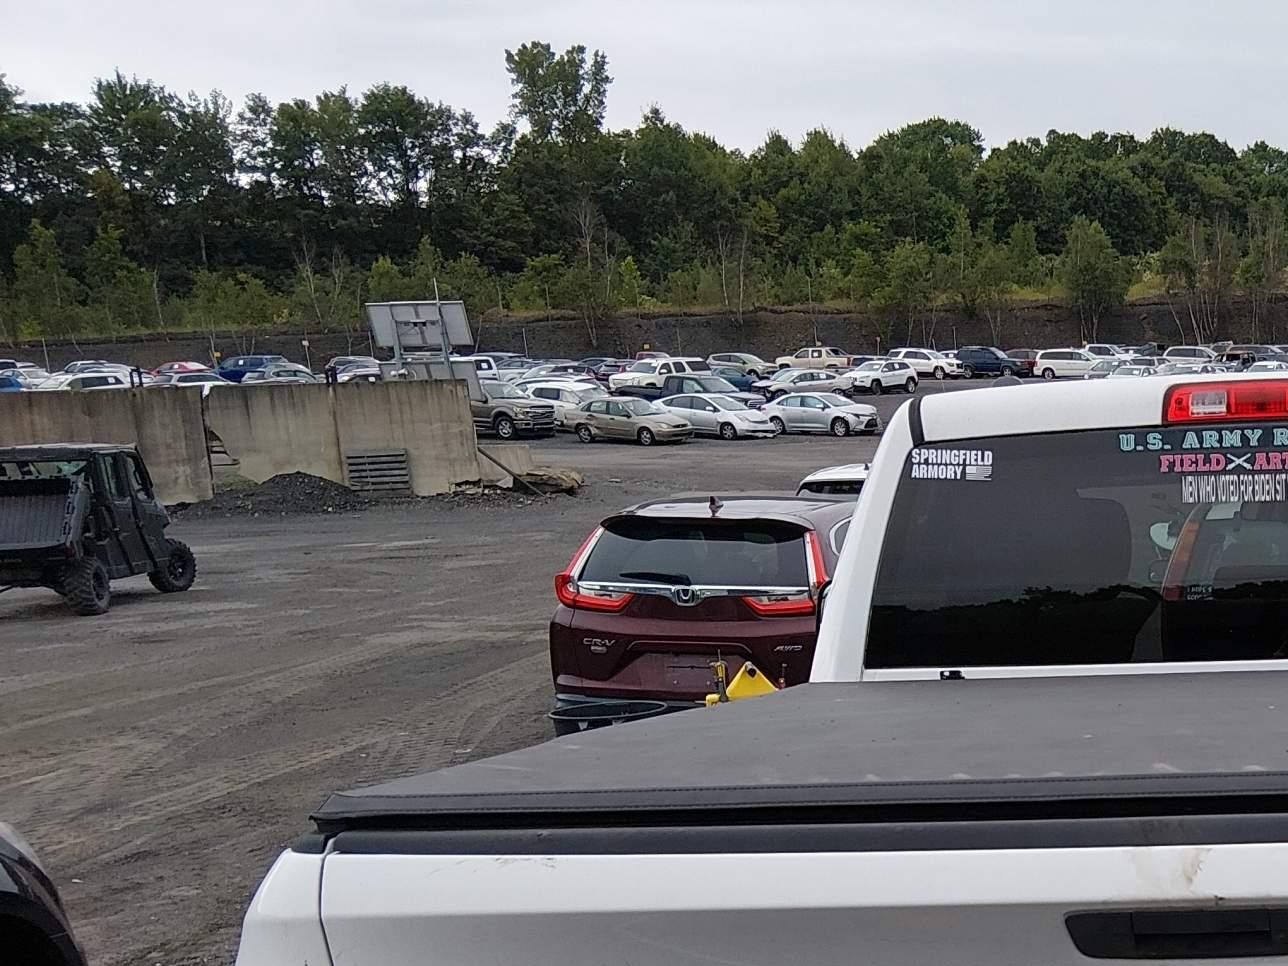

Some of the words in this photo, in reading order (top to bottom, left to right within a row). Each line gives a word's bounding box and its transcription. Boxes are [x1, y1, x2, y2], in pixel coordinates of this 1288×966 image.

[1119, 433, 1171, 450] U.S.
[1182, 429, 1263, 448] ARMY
[911, 448, 993, 465] SPRINGFIELD
[1160, 453, 1226, 472] FIELD
[911, 464, 963, 479] ARMORY
[1182, 475, 1198, 503] MEN
[1199, 475, 1216, 502] WHO
[1217, 474, 1239, 502] VOTED
[1240, 474, 1253, 501] FOR
[1254, 473, 1274, 501] BIDEN
[1276, 473, 1286, 501] SIT
[583, 638, 615, 646] CR-V
